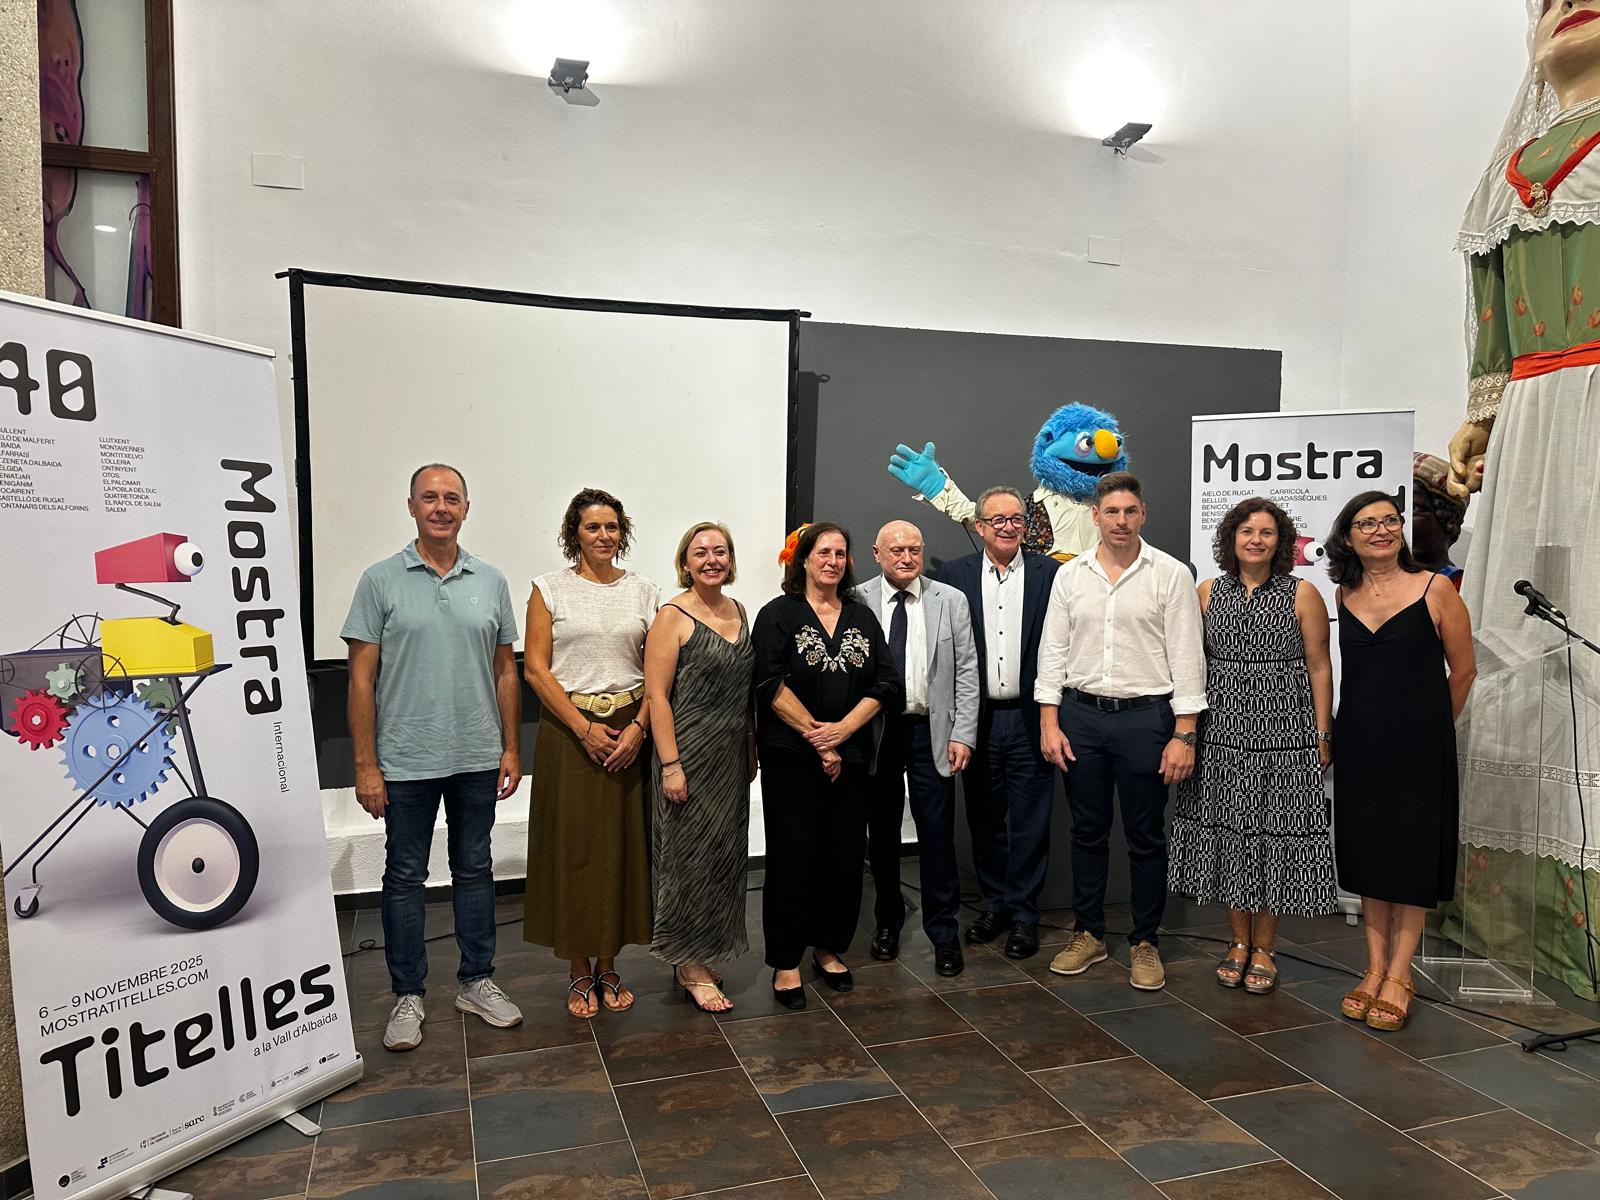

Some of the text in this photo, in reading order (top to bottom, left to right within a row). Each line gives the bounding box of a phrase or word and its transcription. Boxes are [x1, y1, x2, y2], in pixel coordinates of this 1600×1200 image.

[0, 341, 97, 422] 40
[0, 427, 26, 435] ULLENT
[22, 436, 55, 445] MALFERIT
[99, 436, 130, 444] LLUTXENT
[100, 444, 145, 453] MONTAVERNER
[100, 451, 143, 460] MONTITXELVO
[1203, 442, 1383, 483] Mostra
[38, 503, 56, 511] DELS
[220, 458, 285, 715] Mostra
[273, 720, 289, 793] Internacional
[38, 1006, 49, 1019] 6
[71, 995, 82, 1008] 9
[84, 966, 168, 1004] NOVEMBRE
[170, 955, 204, 975] 2025
[40, 969, 209, 1037] MOSTRATITELLES.COM
[40, 963, 336, 1117] Titelles
[253, 1012, 338, 1057] a la Vall d'Albaida
[184, 1115, 204, 1129] sarc
